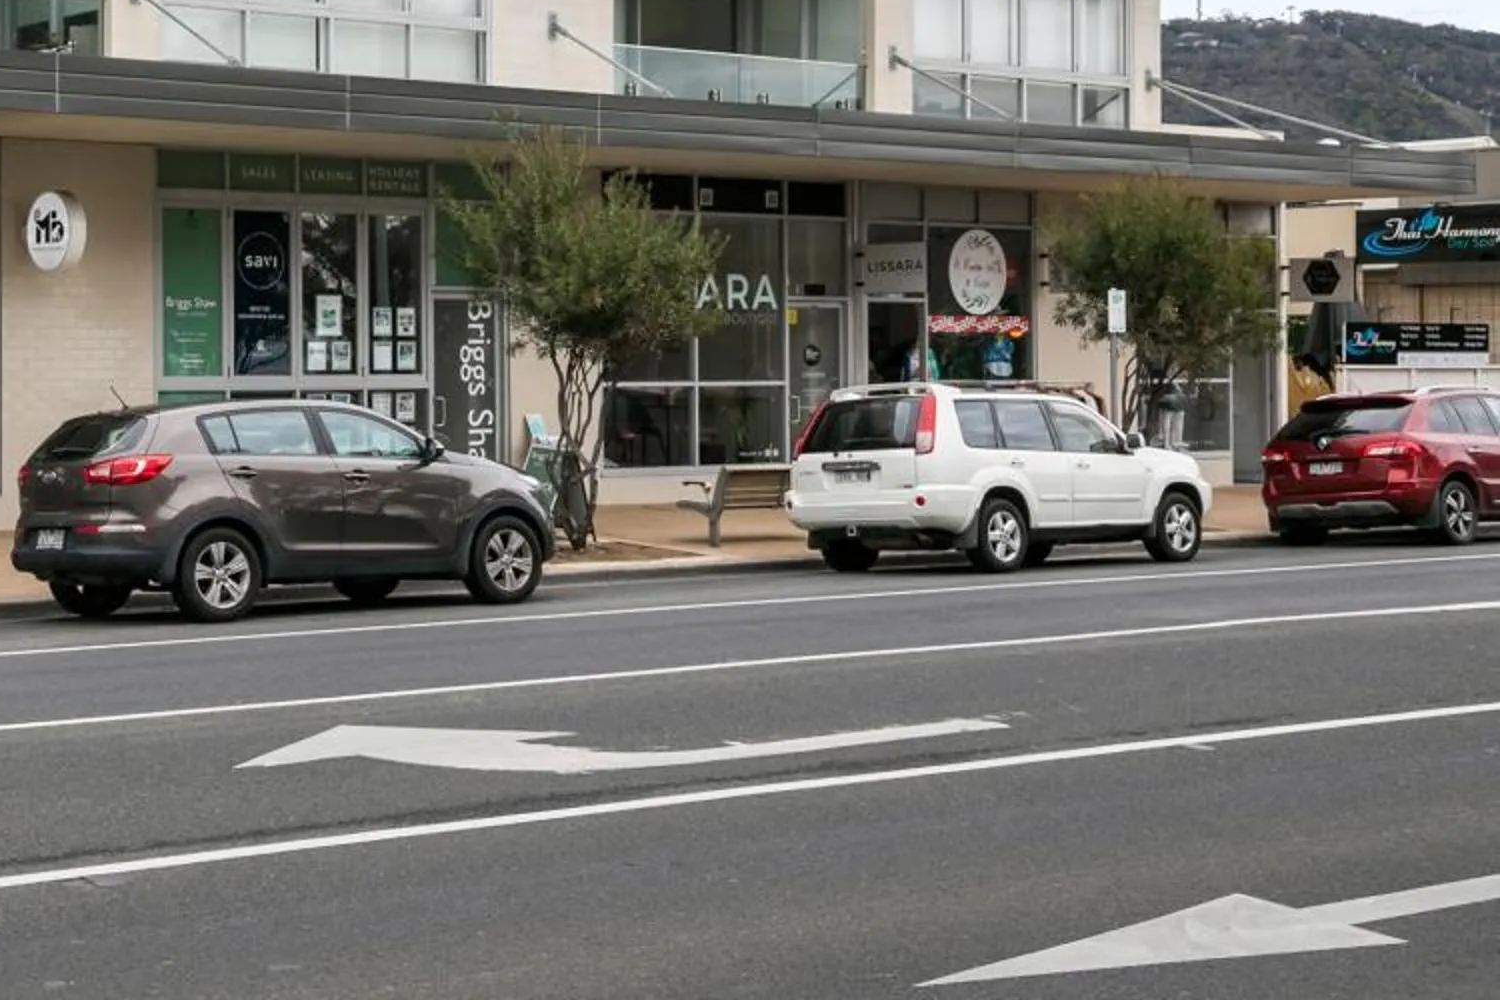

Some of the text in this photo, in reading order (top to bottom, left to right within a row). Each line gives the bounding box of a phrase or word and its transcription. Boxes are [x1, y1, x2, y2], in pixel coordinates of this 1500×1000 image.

[244, 254, 278, 269] savi
[867, 258, 924, 274] LISSARA
[694, 274, 779, 311] ARA
[460, 301, 495, 459] Briggs Sha
